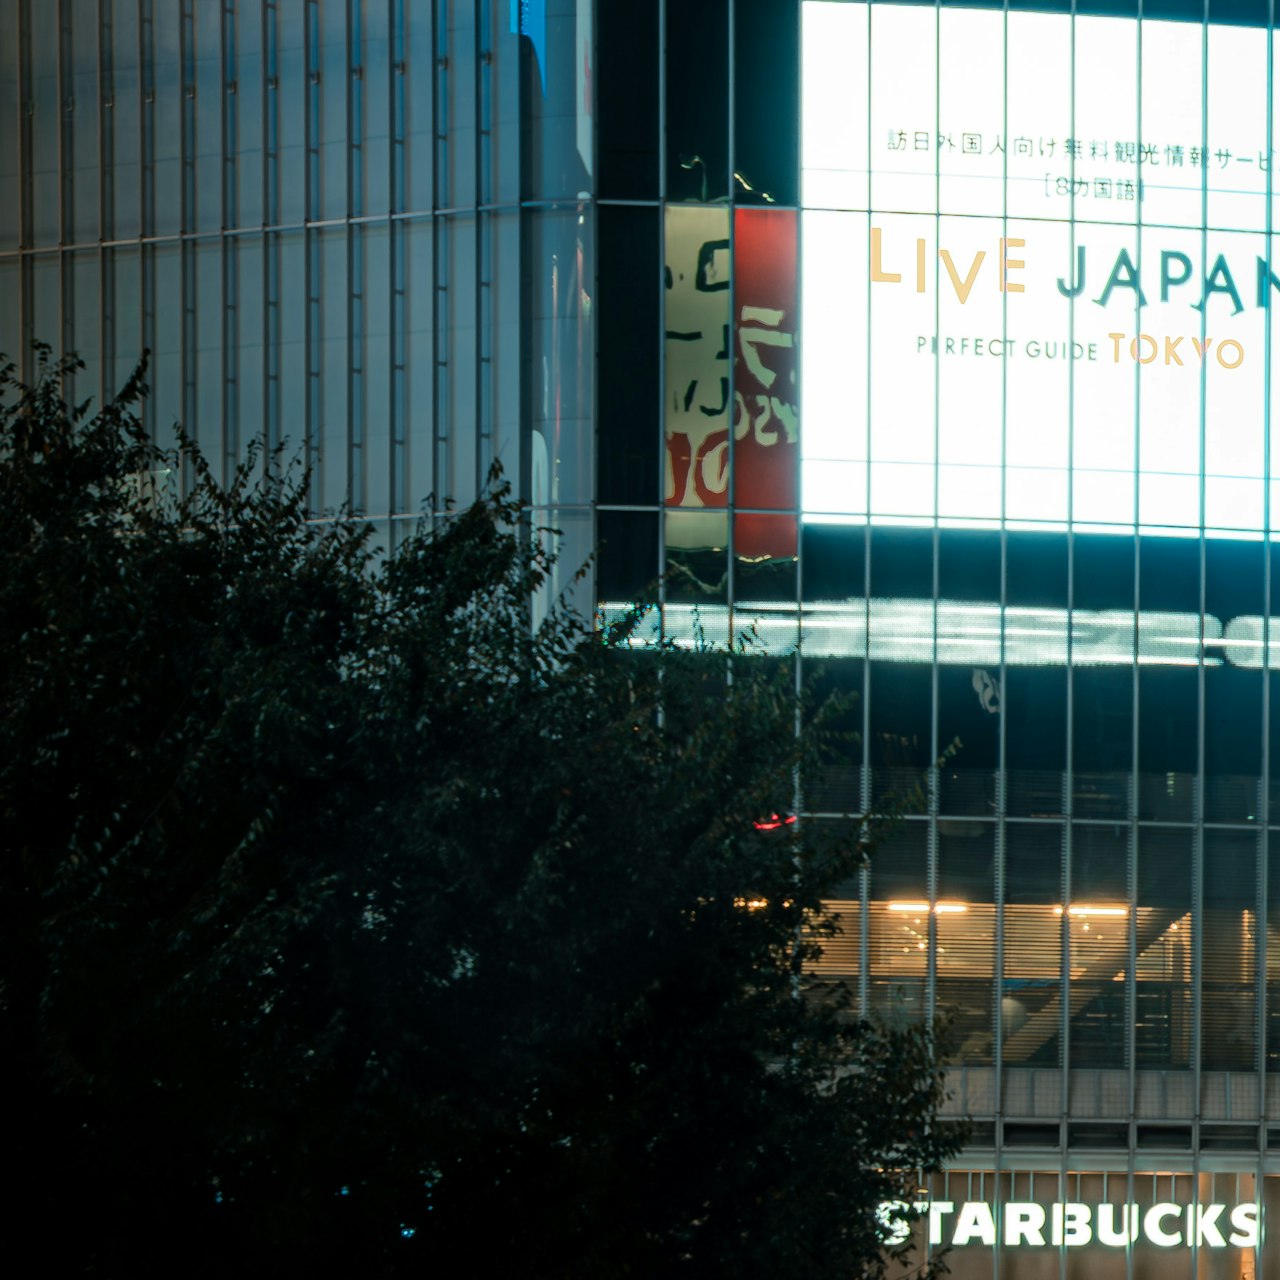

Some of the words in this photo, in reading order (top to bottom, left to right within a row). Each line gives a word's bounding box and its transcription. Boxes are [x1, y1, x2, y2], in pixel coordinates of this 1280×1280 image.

[871, 227, 1026, 305] LIVE
[1026, 340, 1097, 362] GUIDE
[1108, 332, 1244, 370] TOKYO
[872, 1201, 1267, 1248] STARBUCKS
